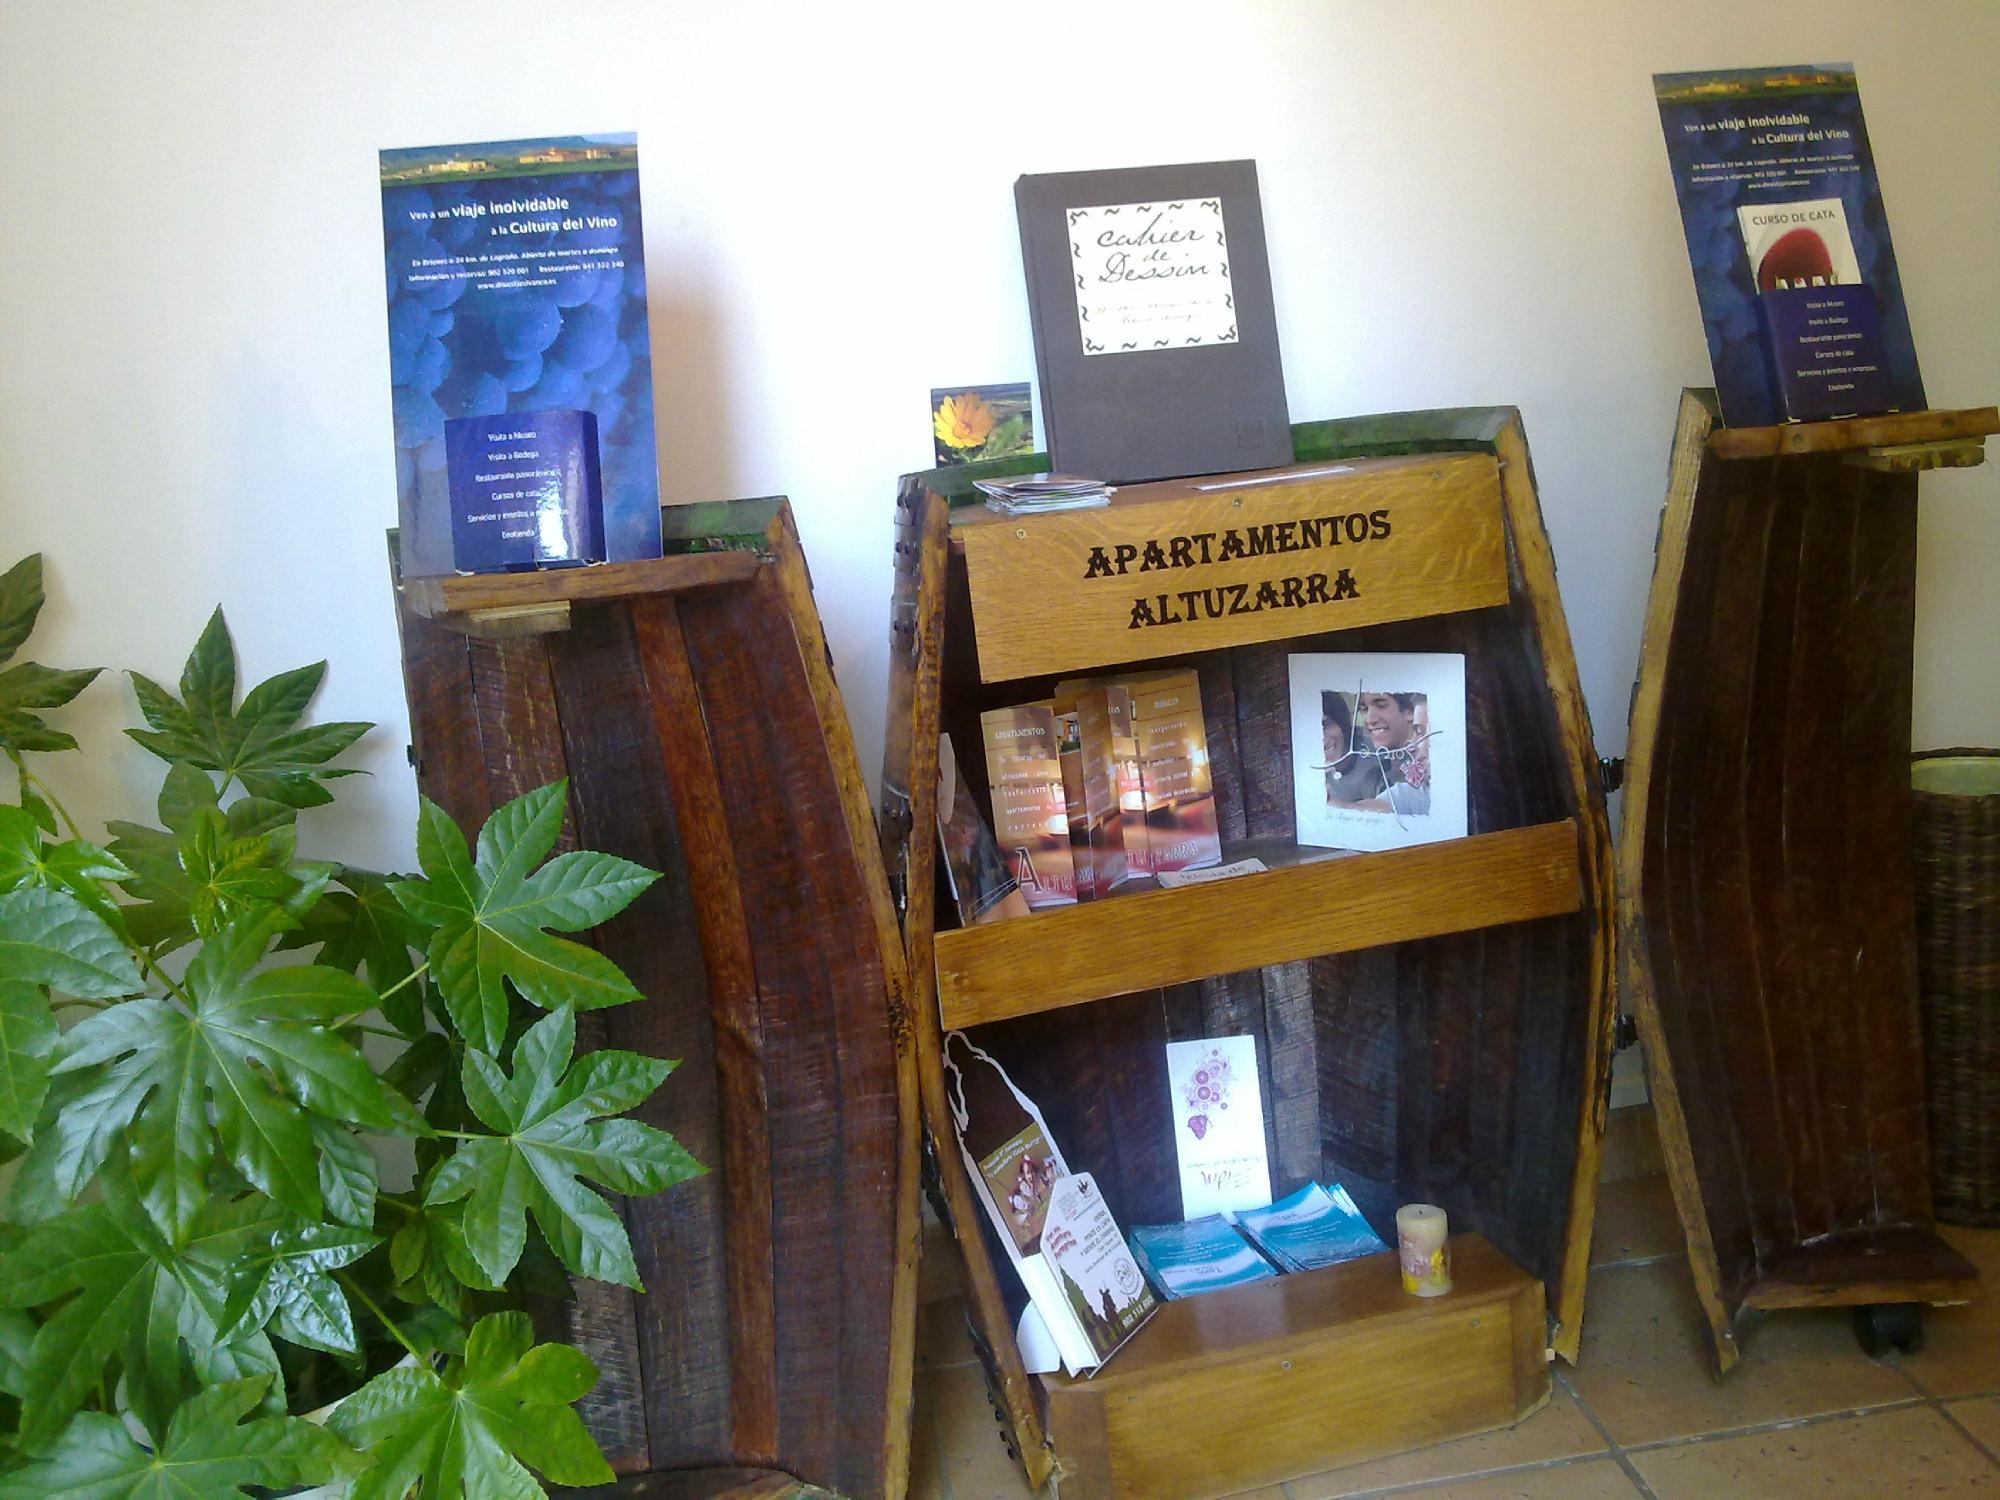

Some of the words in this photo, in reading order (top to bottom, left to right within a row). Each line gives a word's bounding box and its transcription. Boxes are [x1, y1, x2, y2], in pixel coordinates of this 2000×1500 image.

[1718, 119, 1746, 132] viaje
[1748, 114, 1810, 128] inolvidable
[1766, 133, 1805, 144] Cultura
[1807, 131, 1824, 141] del
[1825, 129, 1849, 140] Vino
[409, 210, 428, 220] Ven
[438, 210, 450, 219] un
[452, 204, 486, 219] viaje
[490, 197, 570, 215] inolvidable
[491, 227, 498, 236] a
[499, 226, 508, 235] la
[509, 220, 559, 234] Cultura
[562, 218, 584, 231] del
[589, 216, 618, 228] Vino
[1753, 214, 1788, 226] CURSO
[1792, 213, 1806, 223] DE
[1809, 210, 1835, 220] CATA
[1142, 249, 1171, 262] de
[1098, 252, 1210, 282] Dessin
[491, 492, 514, 501] Cursos
[1083, 510, 1392, 579] APARTAMENTOS
[1128, 568, 1361, 630] ALTUZARRA
[995, 727, 1046, 740] APARTAMENTOS
